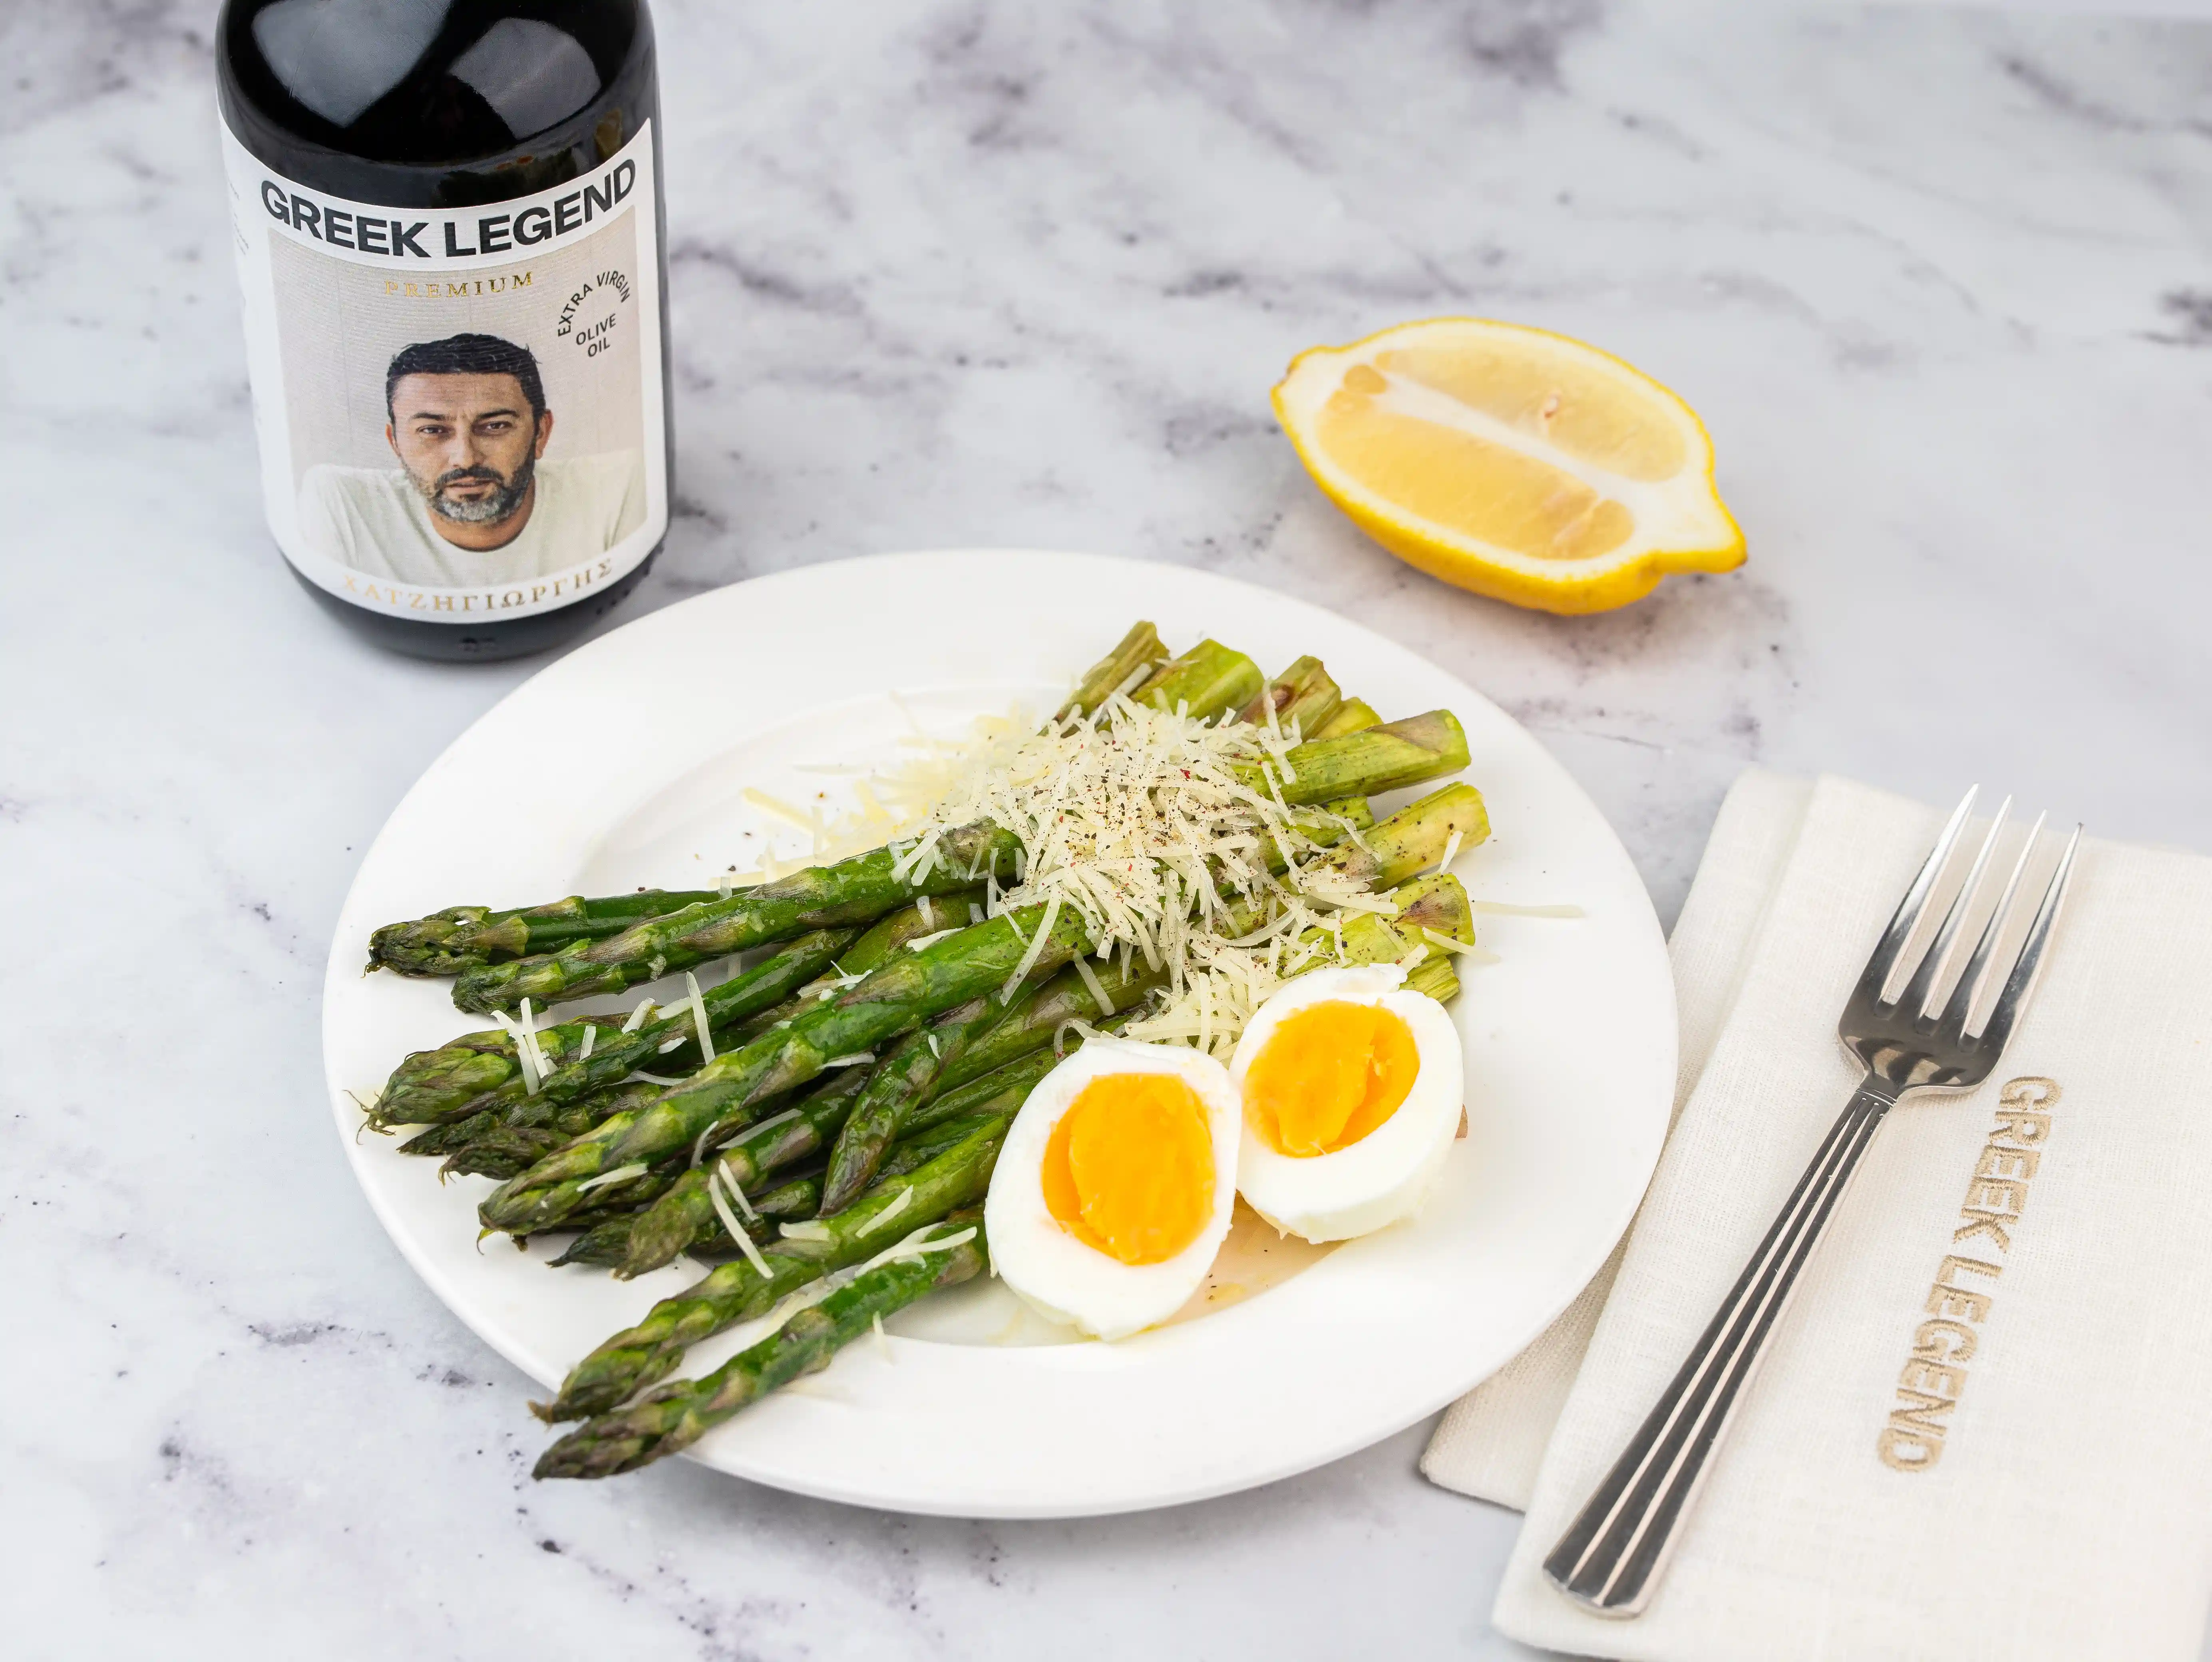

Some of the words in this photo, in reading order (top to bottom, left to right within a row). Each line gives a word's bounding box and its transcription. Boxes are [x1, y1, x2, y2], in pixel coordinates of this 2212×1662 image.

[261, 180, 431, 258] GREEK
[446, 159, 636, 258] LEGEND
[384, 271, 533, 298] PREMIUM
[558, 283, 593, 337] EXTRA
[597, 270, 630, 303] VIRGIN
[576, 313, 617, 346] OLIVE
[587, 337, 611, 358] OIL
[1952, 1076, 2063, 1253] GREEK
[1878, 1254, 2003, 1473] LEGEND
